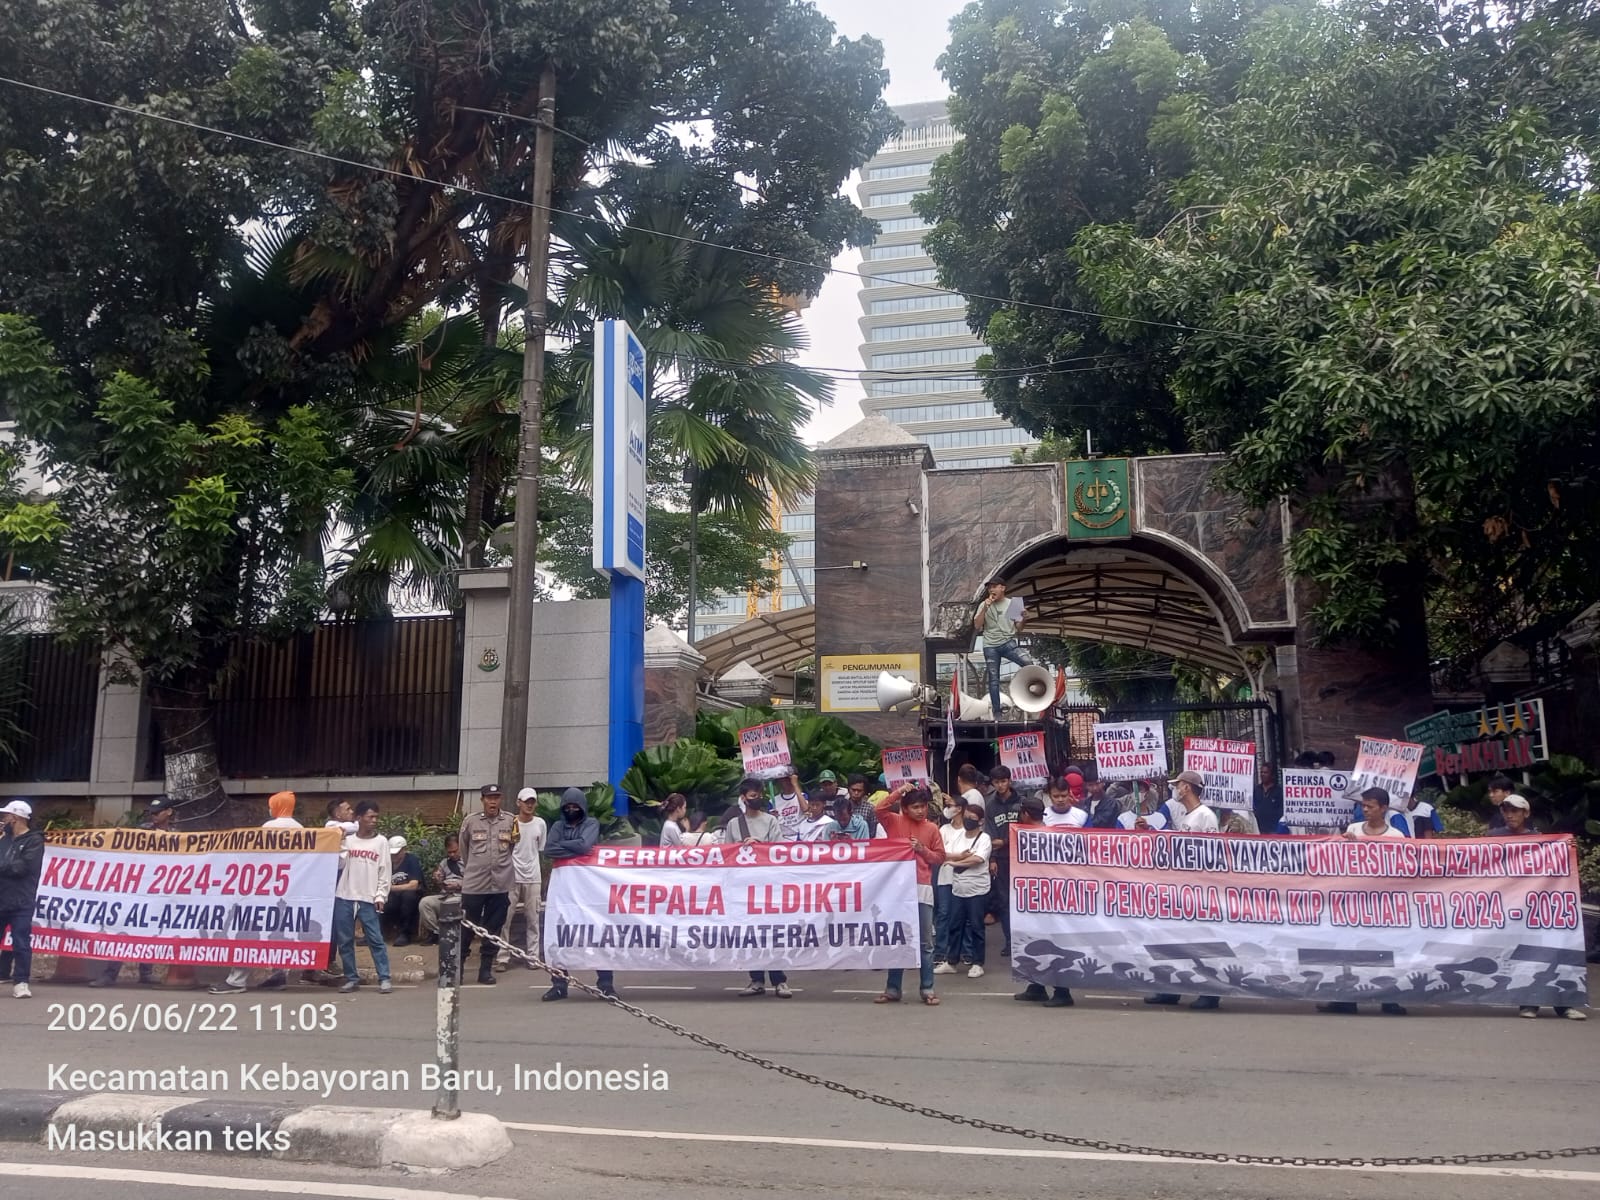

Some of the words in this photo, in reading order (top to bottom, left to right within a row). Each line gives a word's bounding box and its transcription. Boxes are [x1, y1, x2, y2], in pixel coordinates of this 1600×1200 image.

[629, 430, 643, 457] ATM
[842, 663, 902, 671] PENGUMUMAN
[1003, 738, 1014, 752] KIP
[1015, 734, 1039, 750] ADALAH
[1096, 729, 1135, 741] PERIKSA
[1017, 750, 1034, 764] HAK
[1097, 741, 1134, 754] KETUA
[1190, 739, 1218, 752] PERIKSA
[1220, 742, 1225, 751] &
[1227, 743, 1250, 754] COPOT
[1361, 740, 1393, 757] TANGKAP
[1401, 747, 1420, 763] ADILI
[1435, 734, 1533, 777] BerAKHLAK
[1099, 754, 1154, 768] YAYASAN!
[1187, 754, 1218, 772] KEPALA
[1222, 757, 1253, 776] LLDIKTI
[1204, 774, 1230, 788] WILAYAH
[1231, 776, 1234, 788] I
[1285, 775, 1325, 786] PERIKSA
[1225, 790, 1246, 804] UTARA
[1285, 787, 1332, 798] REKTOR
[112, 831, 180, 852] DUGAAN
[186, 830, 317, 852] PENYIMPANGAN
[597, 847, 725, 866] PERIKSA
[736, 845, 757, 865] &
[769, 841, 870, 864] COPOT
[1018, 830, 1087, 865] PERIKSA
[1087, 833, 1154, 869] REKTOR
[1156, 835, 1170, 871] &
[1171, 836, 1228, 872] KETUA
[1228, 838, 1306, 876] YAYASAN
[1306, 841, 1418, 878] UNIVERSITAS
[1419, 843, 1444, 878] AL
[1445, 842, 1506, 878] AZHAR
[1506, 841, 1570, 877] MEDAN
[42, 856, 146, 894] KULIAH
[147, 863, 291, 897] 2024-2025
[608, 884, 726, 916] KEPALA
[746, 881, 863, 915] LLDIKTI
[1014, 877, 1099, 916] TERKAIT
[1103, 881, 1223, 921] PENGELOLA
[1226, 887, 1284, 925] DANA
[1287, 889, 1325, 926] KIP
[1328, 890, 1411, 929] KULIAH
[1413, 891, 1447, 929] TH
[1450, 891, 1505, 929] 2024
[1508, 908, 1523, 920] -
[1525, 891, 1579, 930] 2025
[36, 894, 122, 927] ERSITAS
[124, 903, 226, 931] AL-AZHAR
[231, 906, 312, 933] MEDAN
[556, 924, 662, 949] WILAYAH
[670, 925, 678, 949] I
[687, 923, 820, 949] SUMATERA
[828, 921, 907, 947] UTARA
[63, 938, 90, 954] HAK
[93, 940, 175, 961] MAHASISWA
[179, 945, 229, 962] MISKIN
[233, 947, 316, 965] DIRAMPAS!
